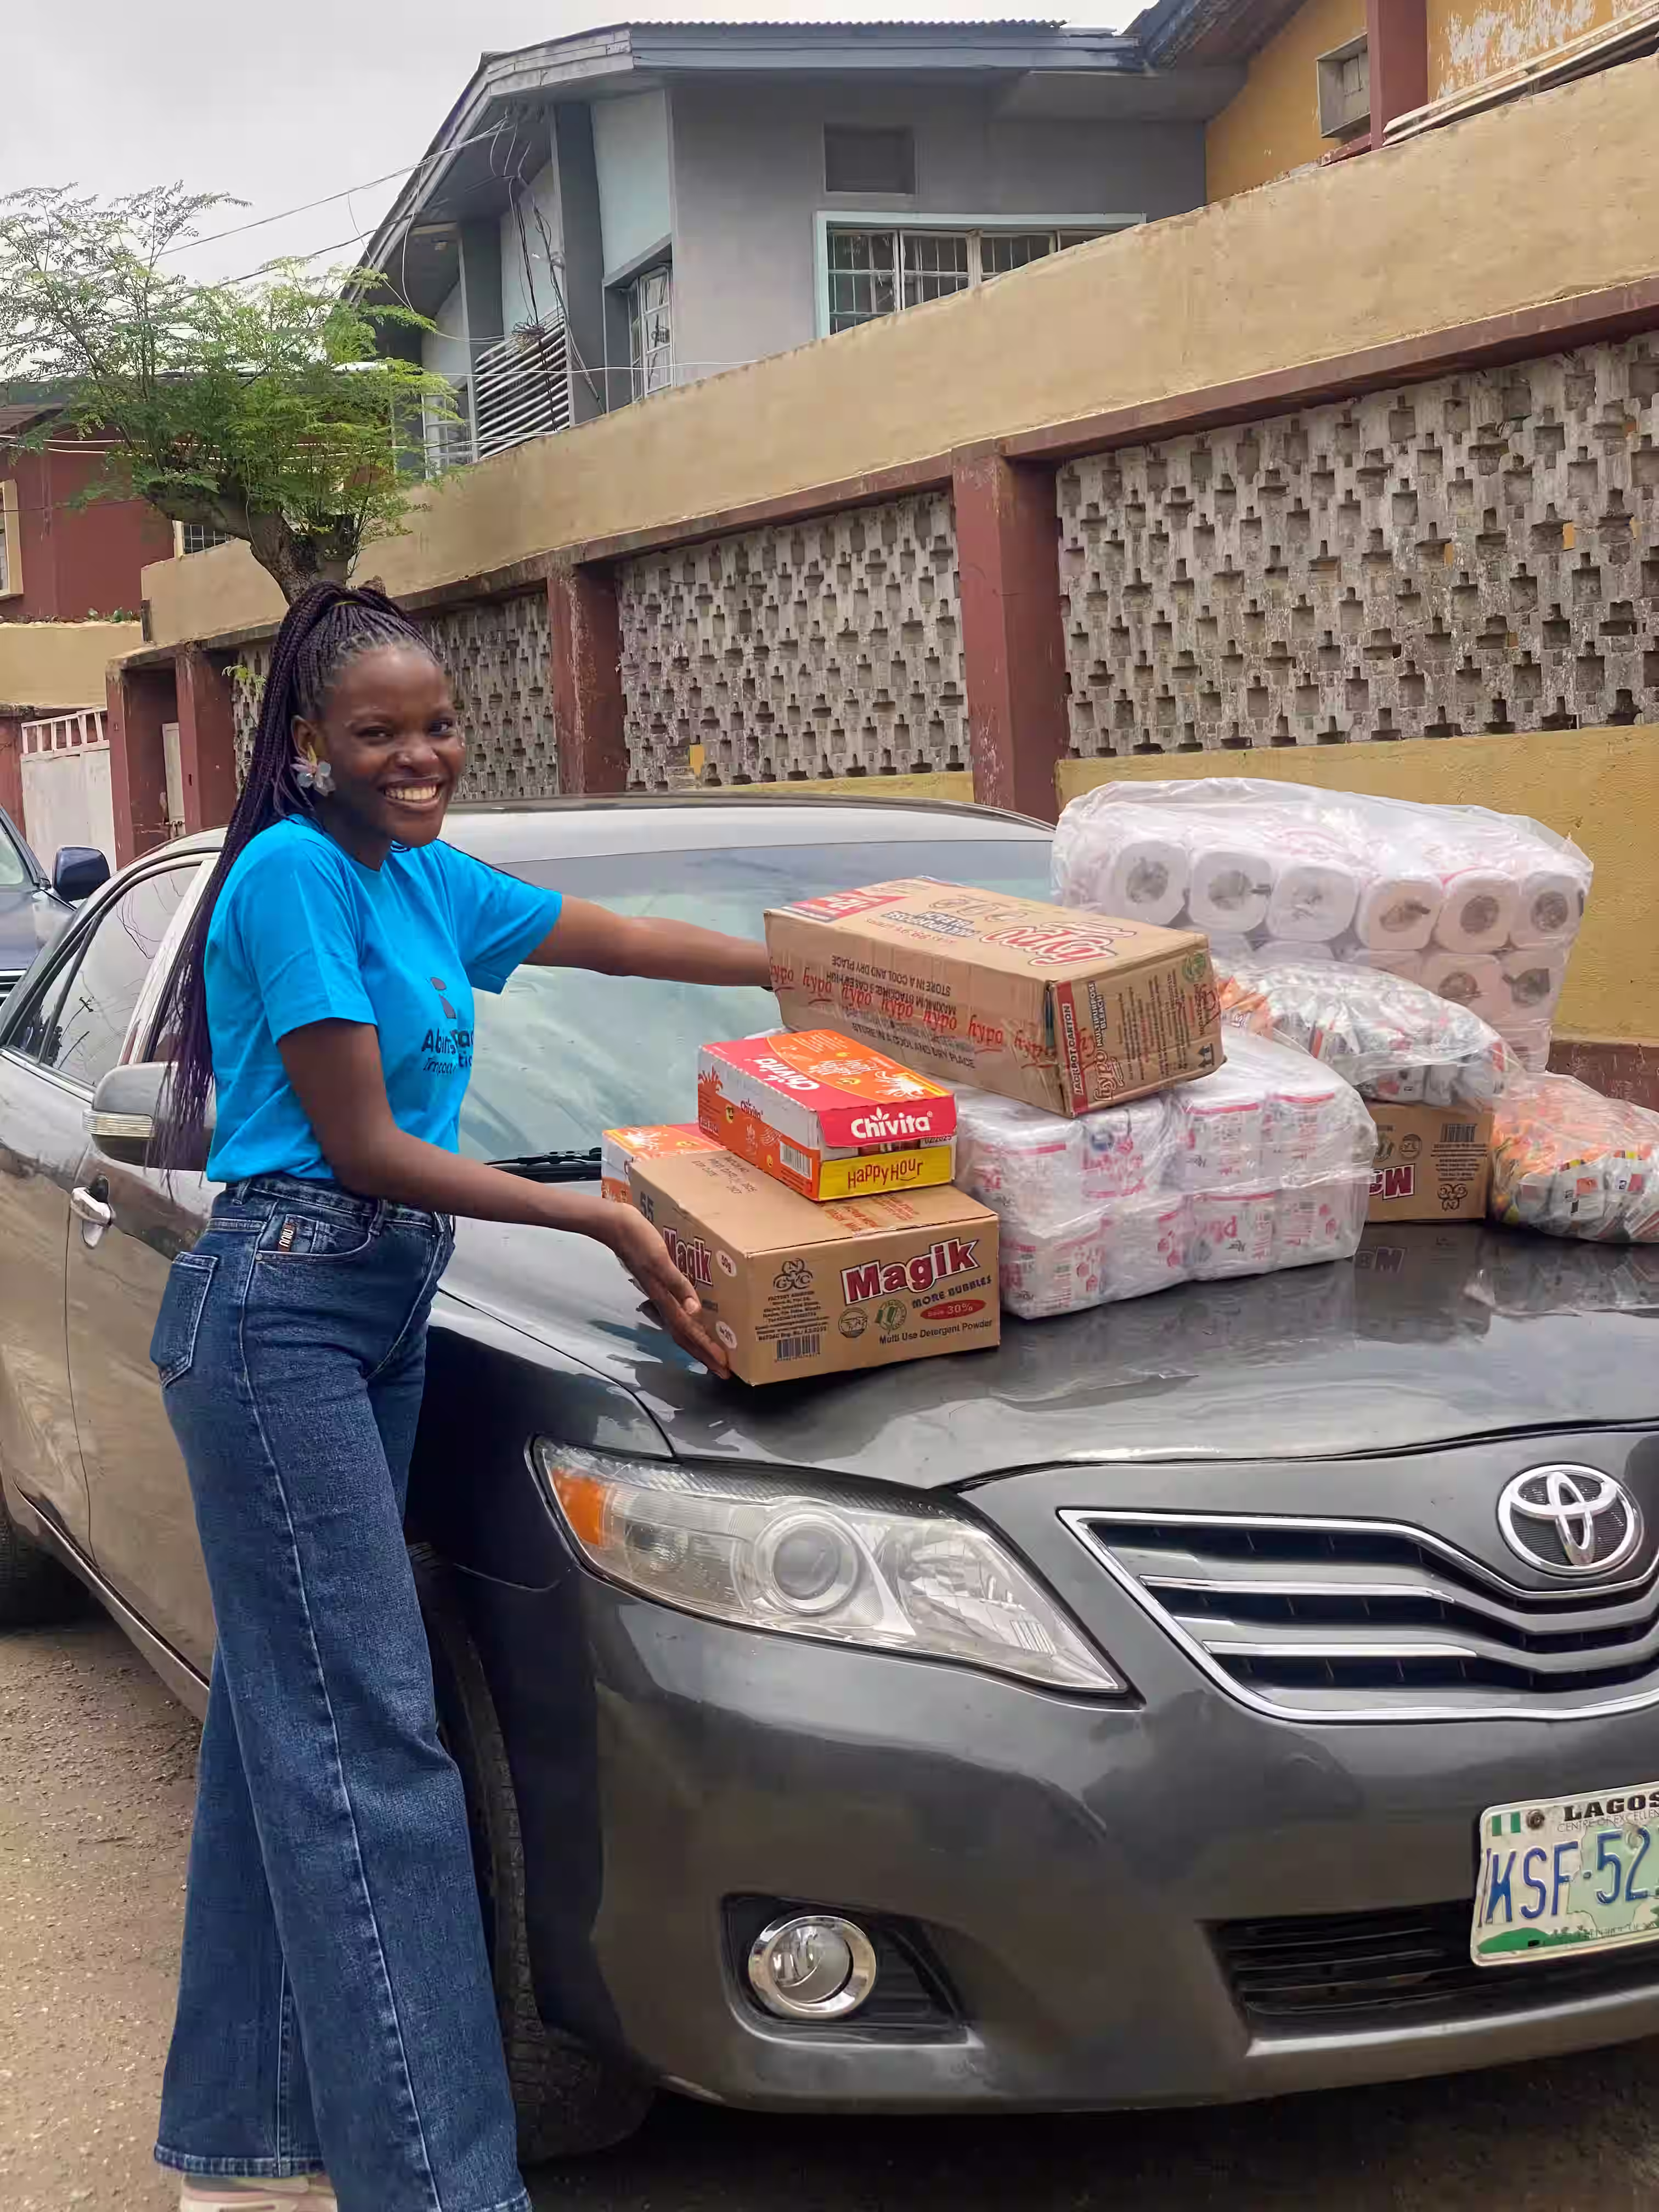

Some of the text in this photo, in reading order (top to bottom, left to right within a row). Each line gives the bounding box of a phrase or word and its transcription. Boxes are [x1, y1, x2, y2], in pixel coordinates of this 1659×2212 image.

[979, 926, 1119, 966] hypo
[831, 955, 951, 996] STORE IN A COOL AND DRY PLACE
[803, 967, 832, 997] hypo
[842, 982, 872, 1008] hypo
[923, 1008, 957, 1033] hypo
[968, 1014, 1004, 1045] hypo
[1064, 1005, 1083, 1094] JACKPOT CARTON
[754, 1058, 820, 1090] Chivita
[1094, 1050, 1115, 1101] hypo
[851, 1107, 931, 1138] Chivita
[848, 1164, 889, 1190] Happy
[840, 1238, 980, 1306] Magik
[912, 1291, 945, 1309] MORE
[949, 1274, 992, 1297] BUBBLES
[946, 1302, 973, 1314] 30%
[879, 1319, 993, 1345] Multi Use Detergent Powder
[1564, 1791, 1659, 1821] LAGOS
